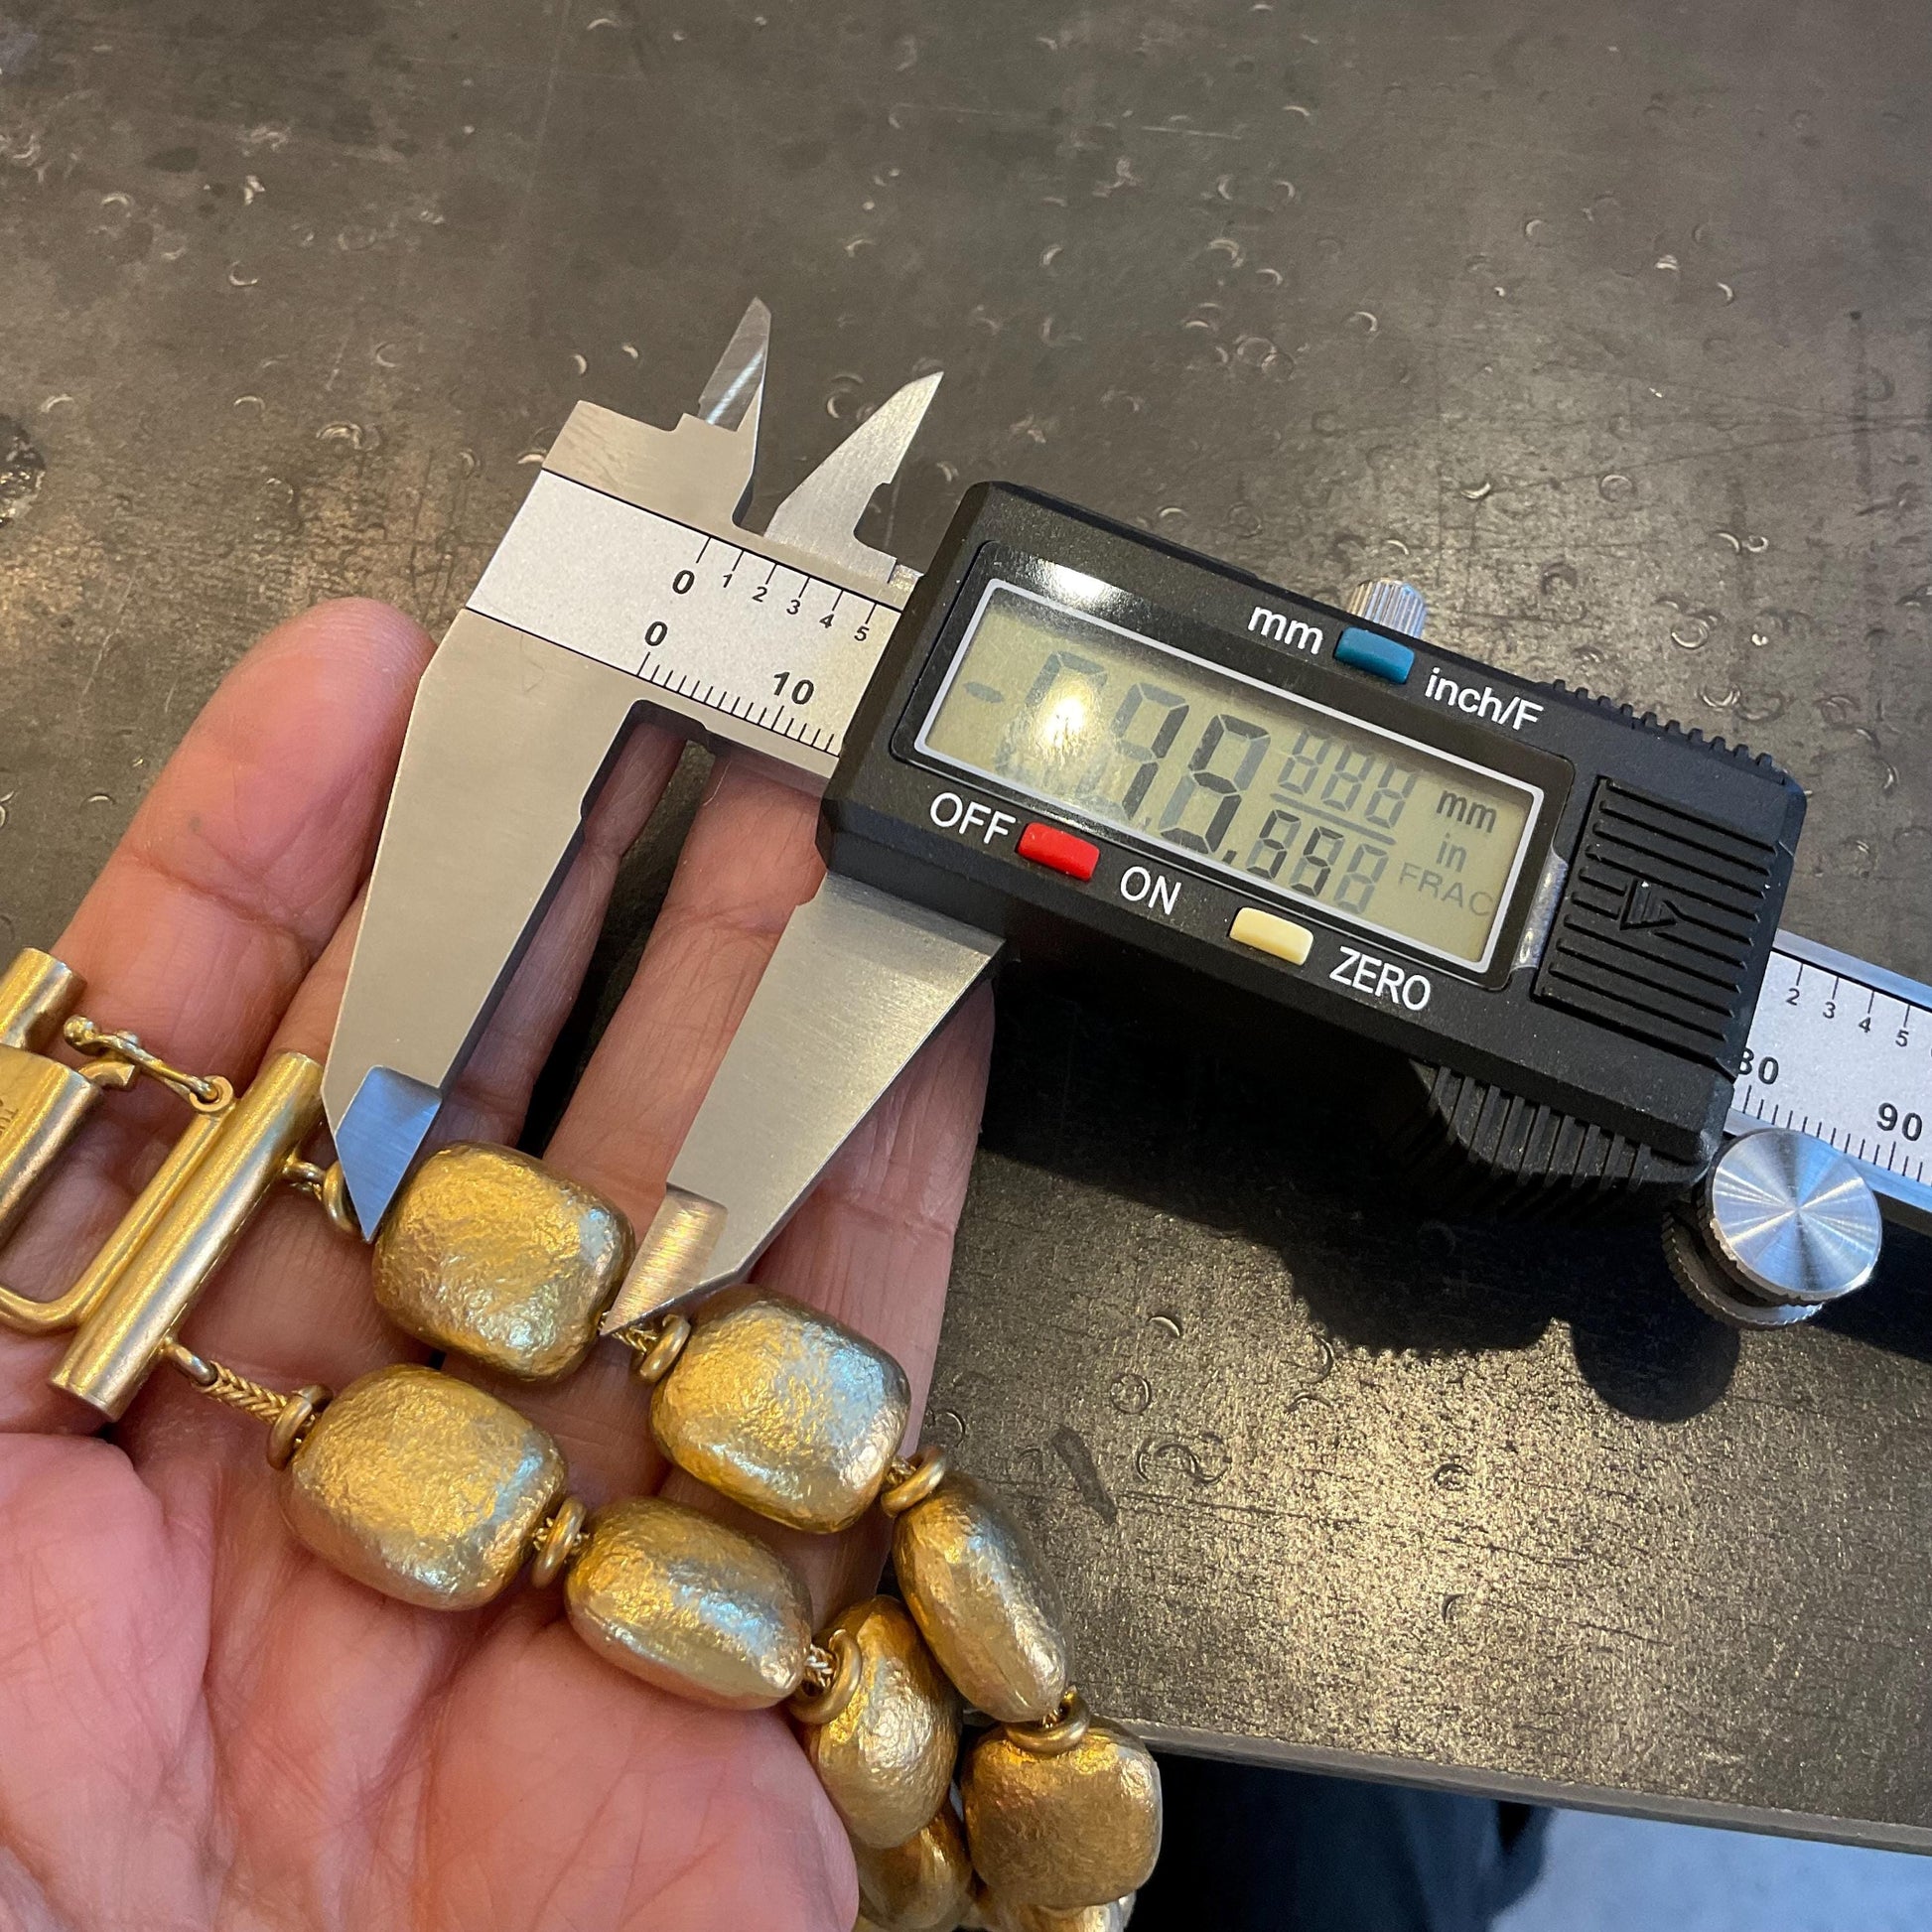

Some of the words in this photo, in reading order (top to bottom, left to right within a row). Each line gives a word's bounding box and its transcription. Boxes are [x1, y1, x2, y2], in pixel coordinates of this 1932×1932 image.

[672, 569, 695, 595] 0
[722, 573, 734, 589] 1
[752, 586, 767, 603] 2
[785, 599, 801, 616] 3
[819, 613, 835, 629] 4
[853, 625, 869, 642] 5
[1248, 607, 1323, 654] mm
[644, 621, 668, 647] 0
[772, 671, 815, 705] 10
[1425, 667, 1544, 730] inch/F
[930, 792, 1017, 844] OFF
[1436, 789, 1497, 833] mm
[1120, 866, 1181, 915] ON
[1328, 946, 1431, 1011] ZERO
[1785, 988, 1800, 1007] 2
[1822, 1001, 1836, 1020] 3
[1859, 1017, 1871, 1034] 4
[1895, 1029, 1909, 1047] 5
[1876, 1102, 1923, 1142] 90
